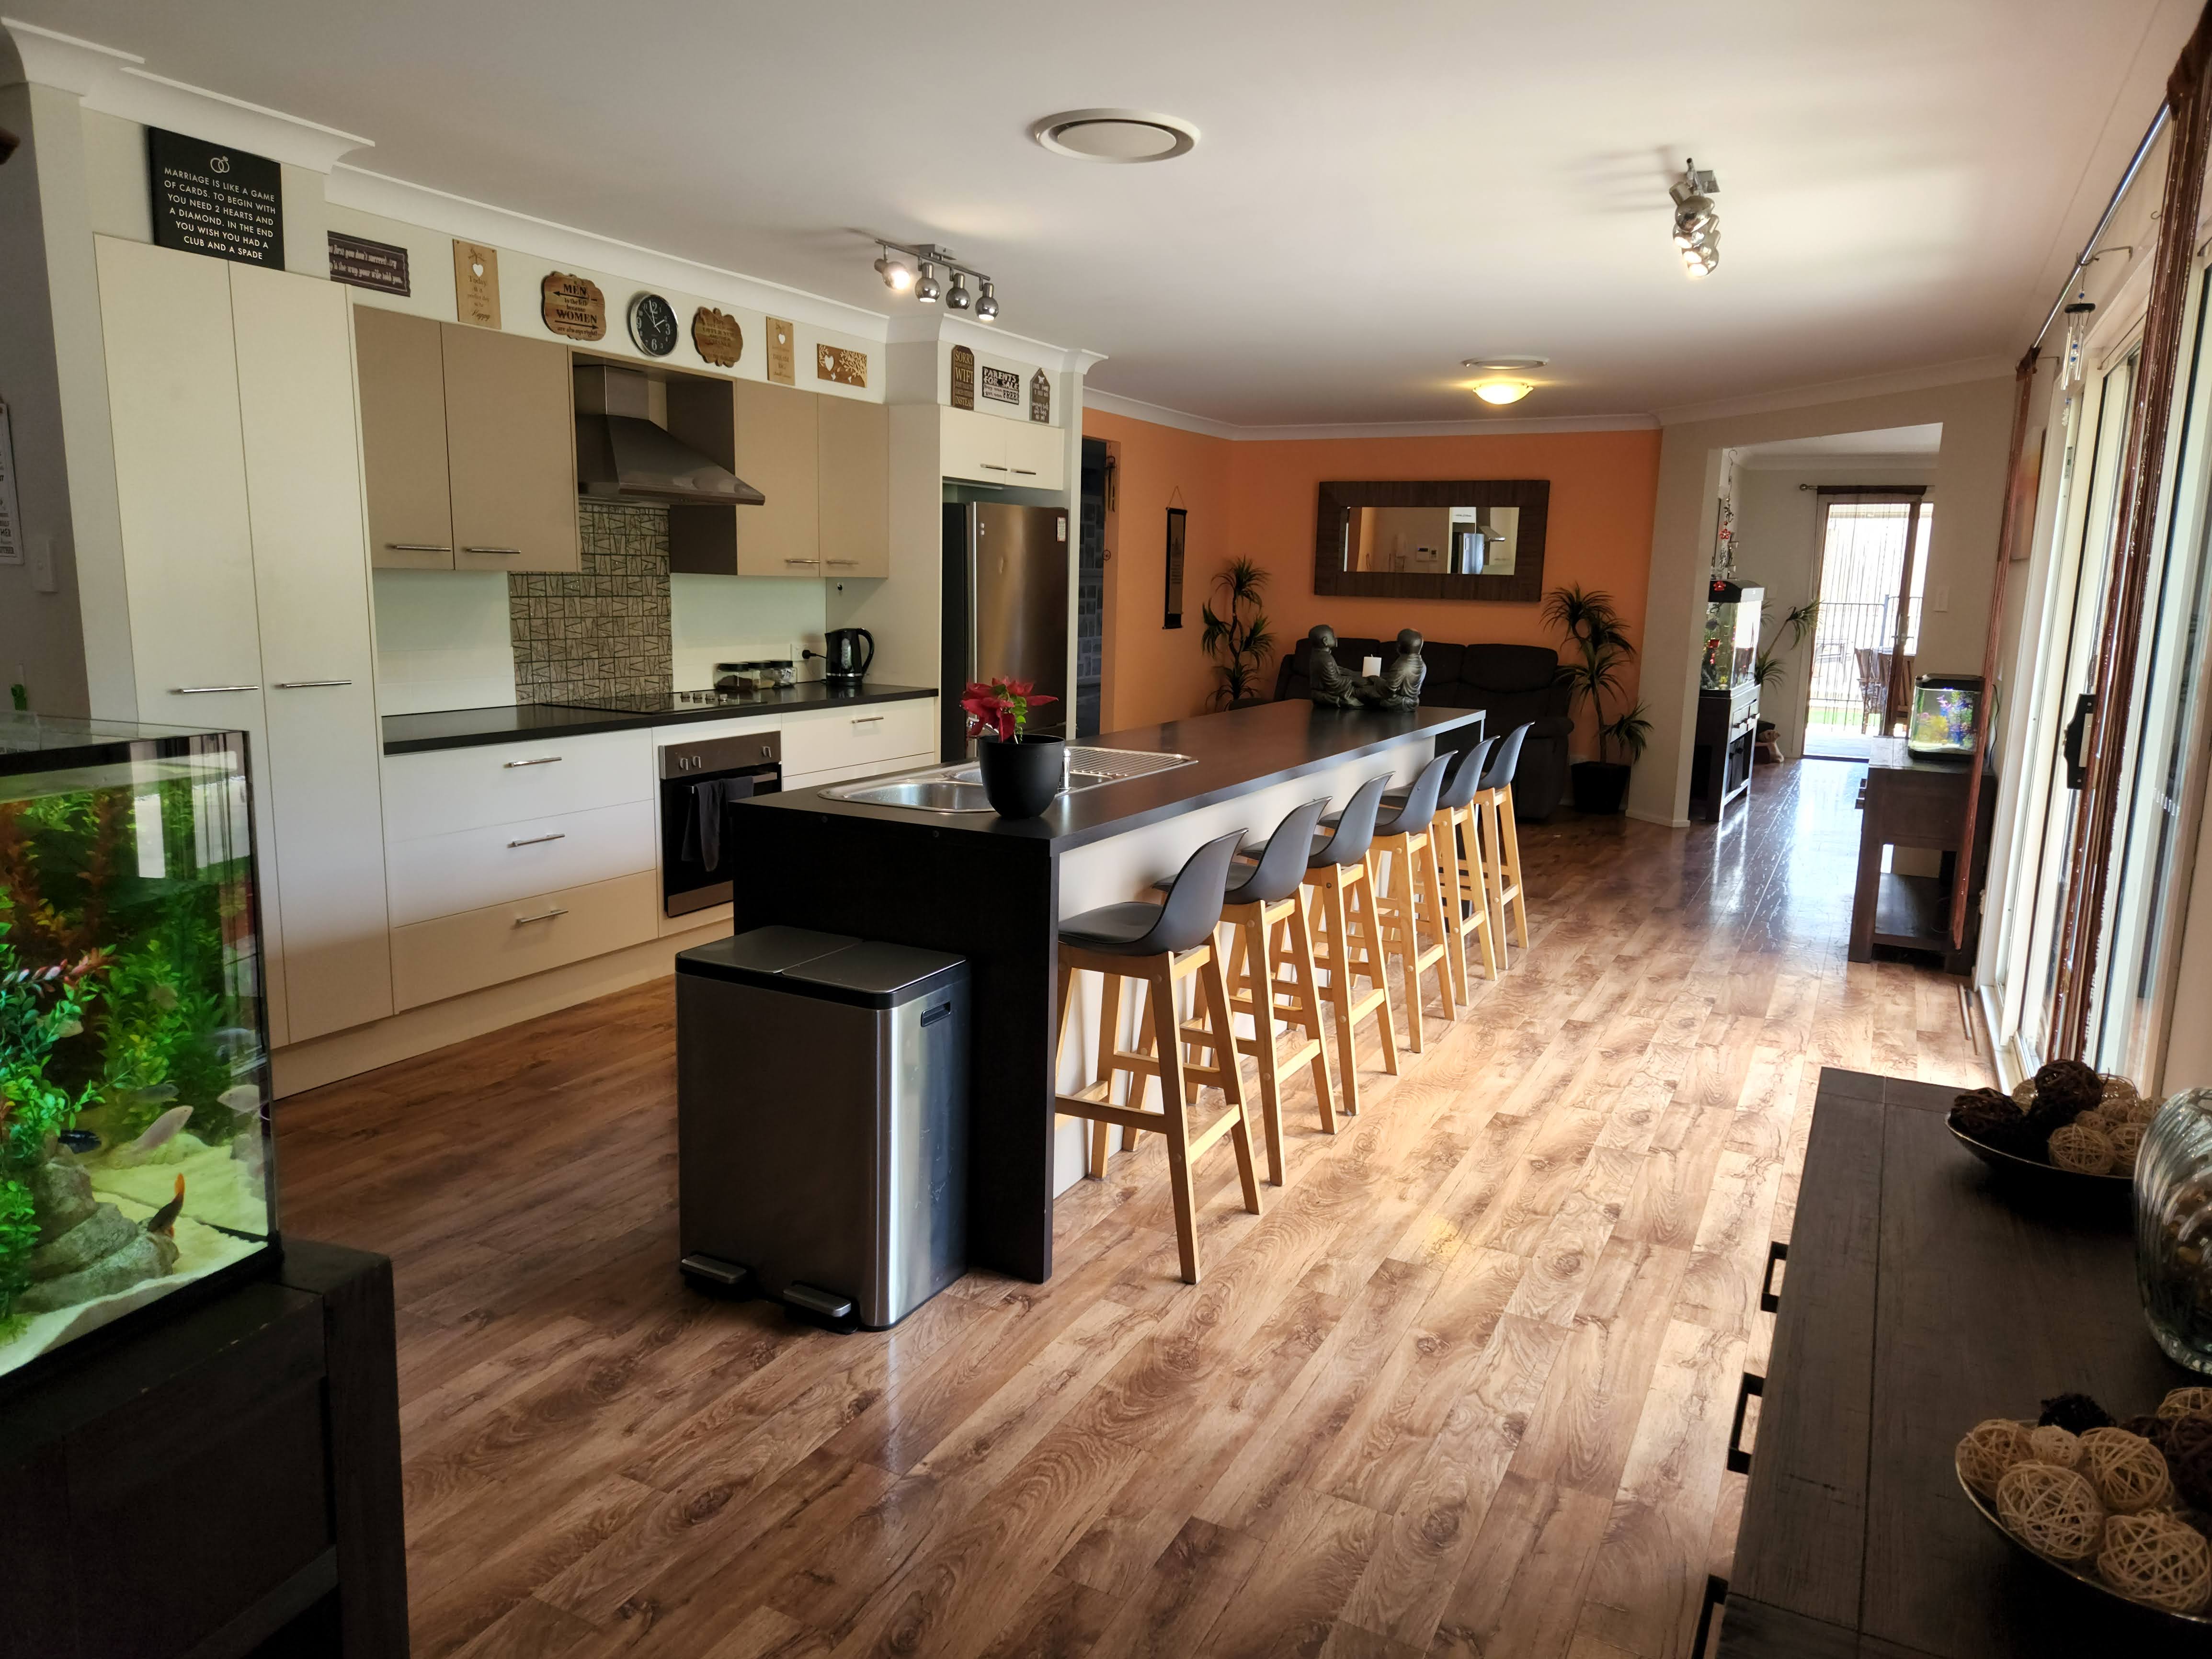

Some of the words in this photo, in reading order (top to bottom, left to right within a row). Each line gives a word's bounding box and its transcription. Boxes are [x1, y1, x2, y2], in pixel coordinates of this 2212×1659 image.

[164, 168, 209, 186] MARRIAGE
[212, 179, 220, 187] IS
[223, 182, 239, 193] LIKE
[251, 190, 275, 202] GAME
[164, 180, 176, 189] OF
[180, 183, 210, 198] CARDS.
[213, 192, 224, 201] TO
[228, 196, 252, 209] BEGIN
[255, 203, 275, 214] WITH
[168, 193, 186, 205] YOU
[190, 199, 212, 211] NEED
[223, 208, 253, 221] HEARTS
[256, 216, 274, 226] AND
[179, 209, 224, 227] DIAMOND.
[228, 220, 236, 229] IN
[239, 224, 254, 234] THE
[257, 227, 273, 238] END
[176, 221, 194, 232] YOU
[197, 226, 219, 238] WISH
[222, 232, 239, 242] YOU
[243, 237, 260, 247] HAD
[262, 241, 269, 249] A
[184, 236, 205, 247] CLUB
[207, 241, 226, 251] AND
[238, 248, 263, 260] SPADE
[345, 249, 354, 259] you
[359, 268, 371, 277] your
[468, 275, 487, 287] Today
[563, 284, 587, 295] MEN
[567, 304, 586, 312] because
[556, 309, 597, 324] WOMEN
[636, 317, 642, 329] 9
[566, 327, 583, 335] always
[665, 323, 671, 335] 3
[651, 338, 657, 351] 6
[955, 351, 974, 365] SORRY
[955, 367, 973, 384] WIFI
[984, 368, 1016, 383] PARENTS
[984, 375, 999, 386] FOR
[1002, 380, 1019, 390] SALE
[955, 396, 973, 407] INSTEAD
